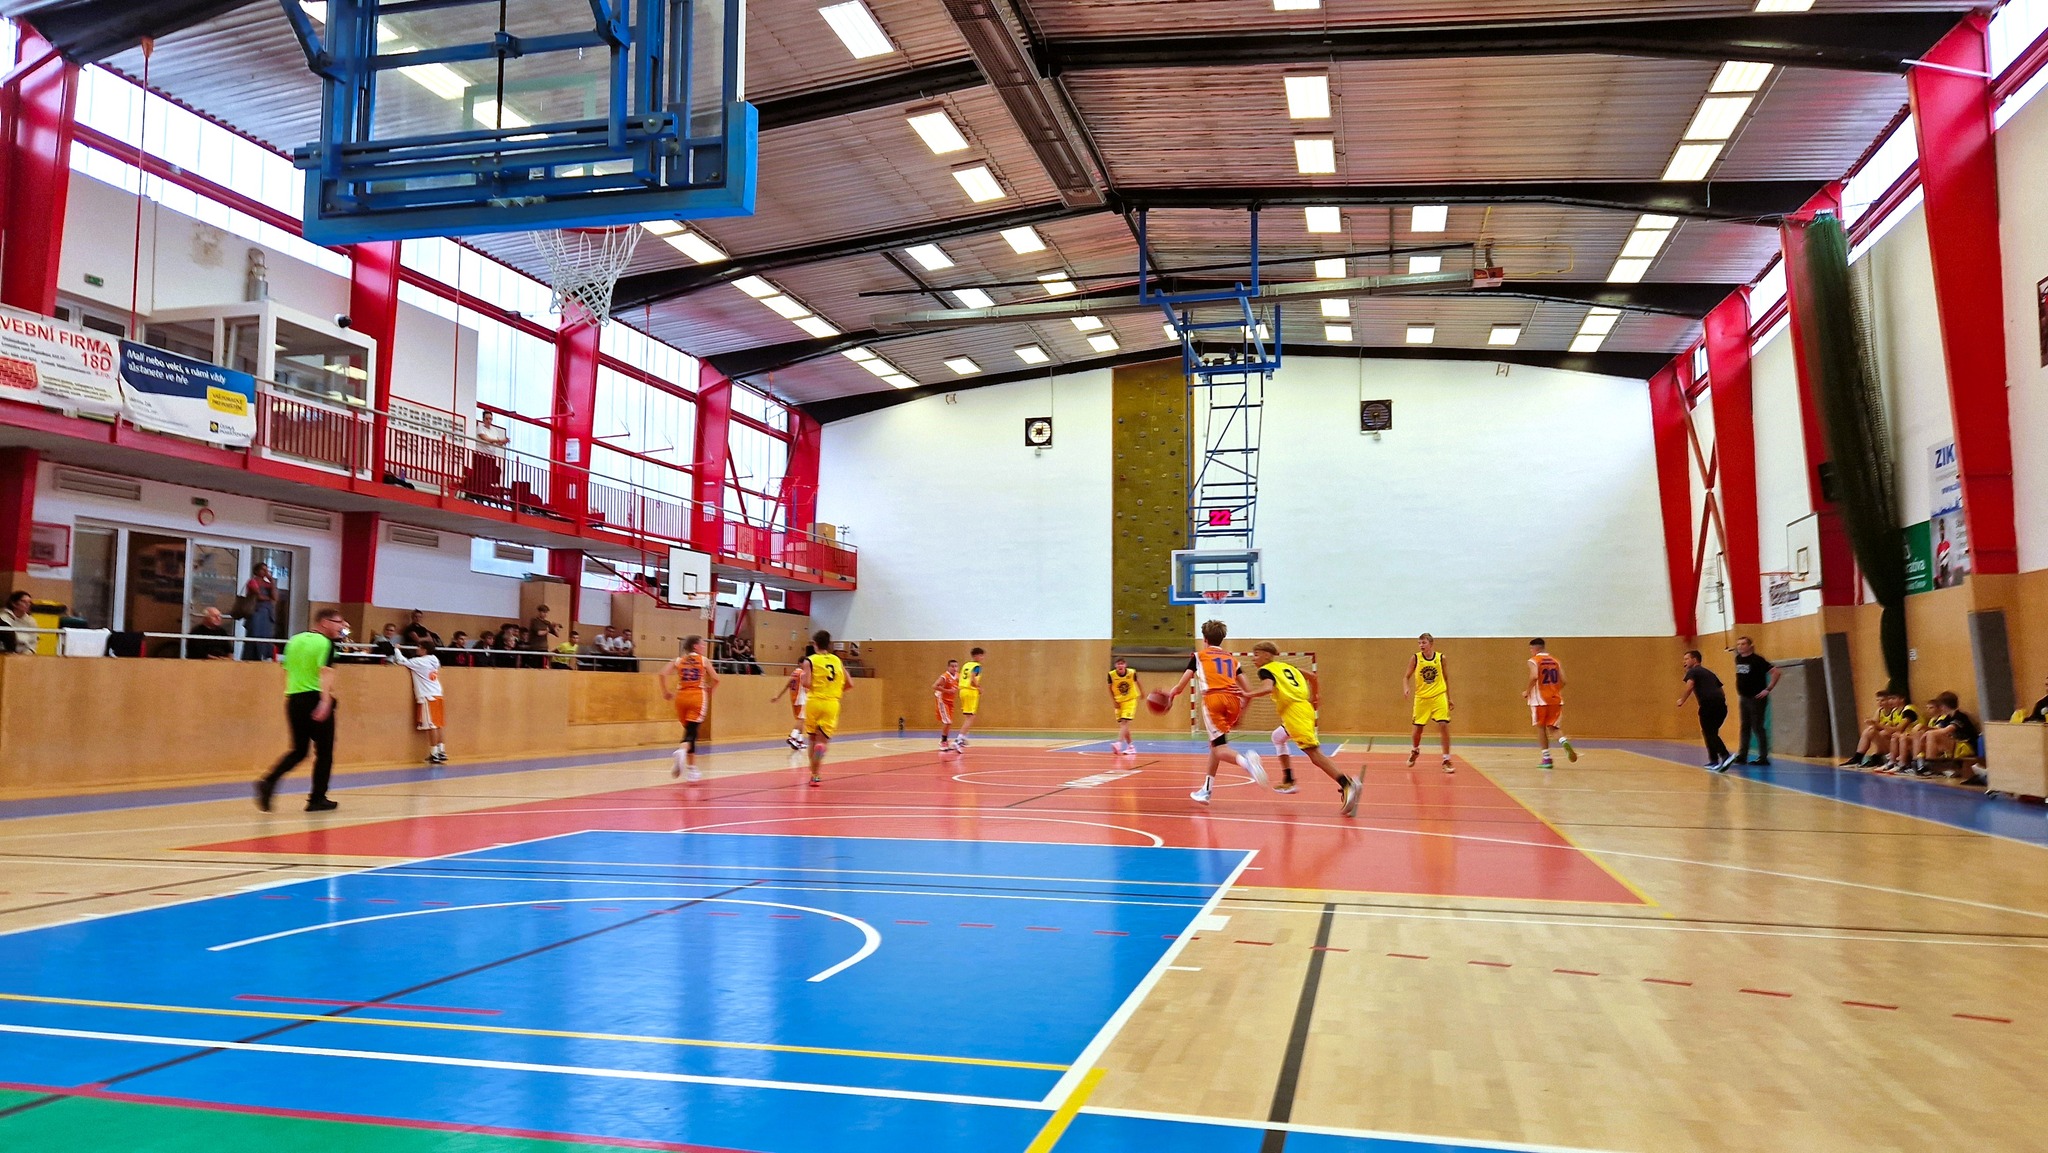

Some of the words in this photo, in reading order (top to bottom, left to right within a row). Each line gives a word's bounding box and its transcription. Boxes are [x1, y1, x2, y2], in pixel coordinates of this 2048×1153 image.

[59, 331, 112, 357] FIRMA
[81, 352, 111, 372] 18D
[145, 356, 166, 369] nebo
[165, 372, 175, 382] ve
[1210, 510, 1231, 525] 22
[825, 664, 836, 682] 3
[1212, 657, 1233, 679] 11
[1541, 668, 1558, 684] 20
[1282, 668, 1299, 687] 9
